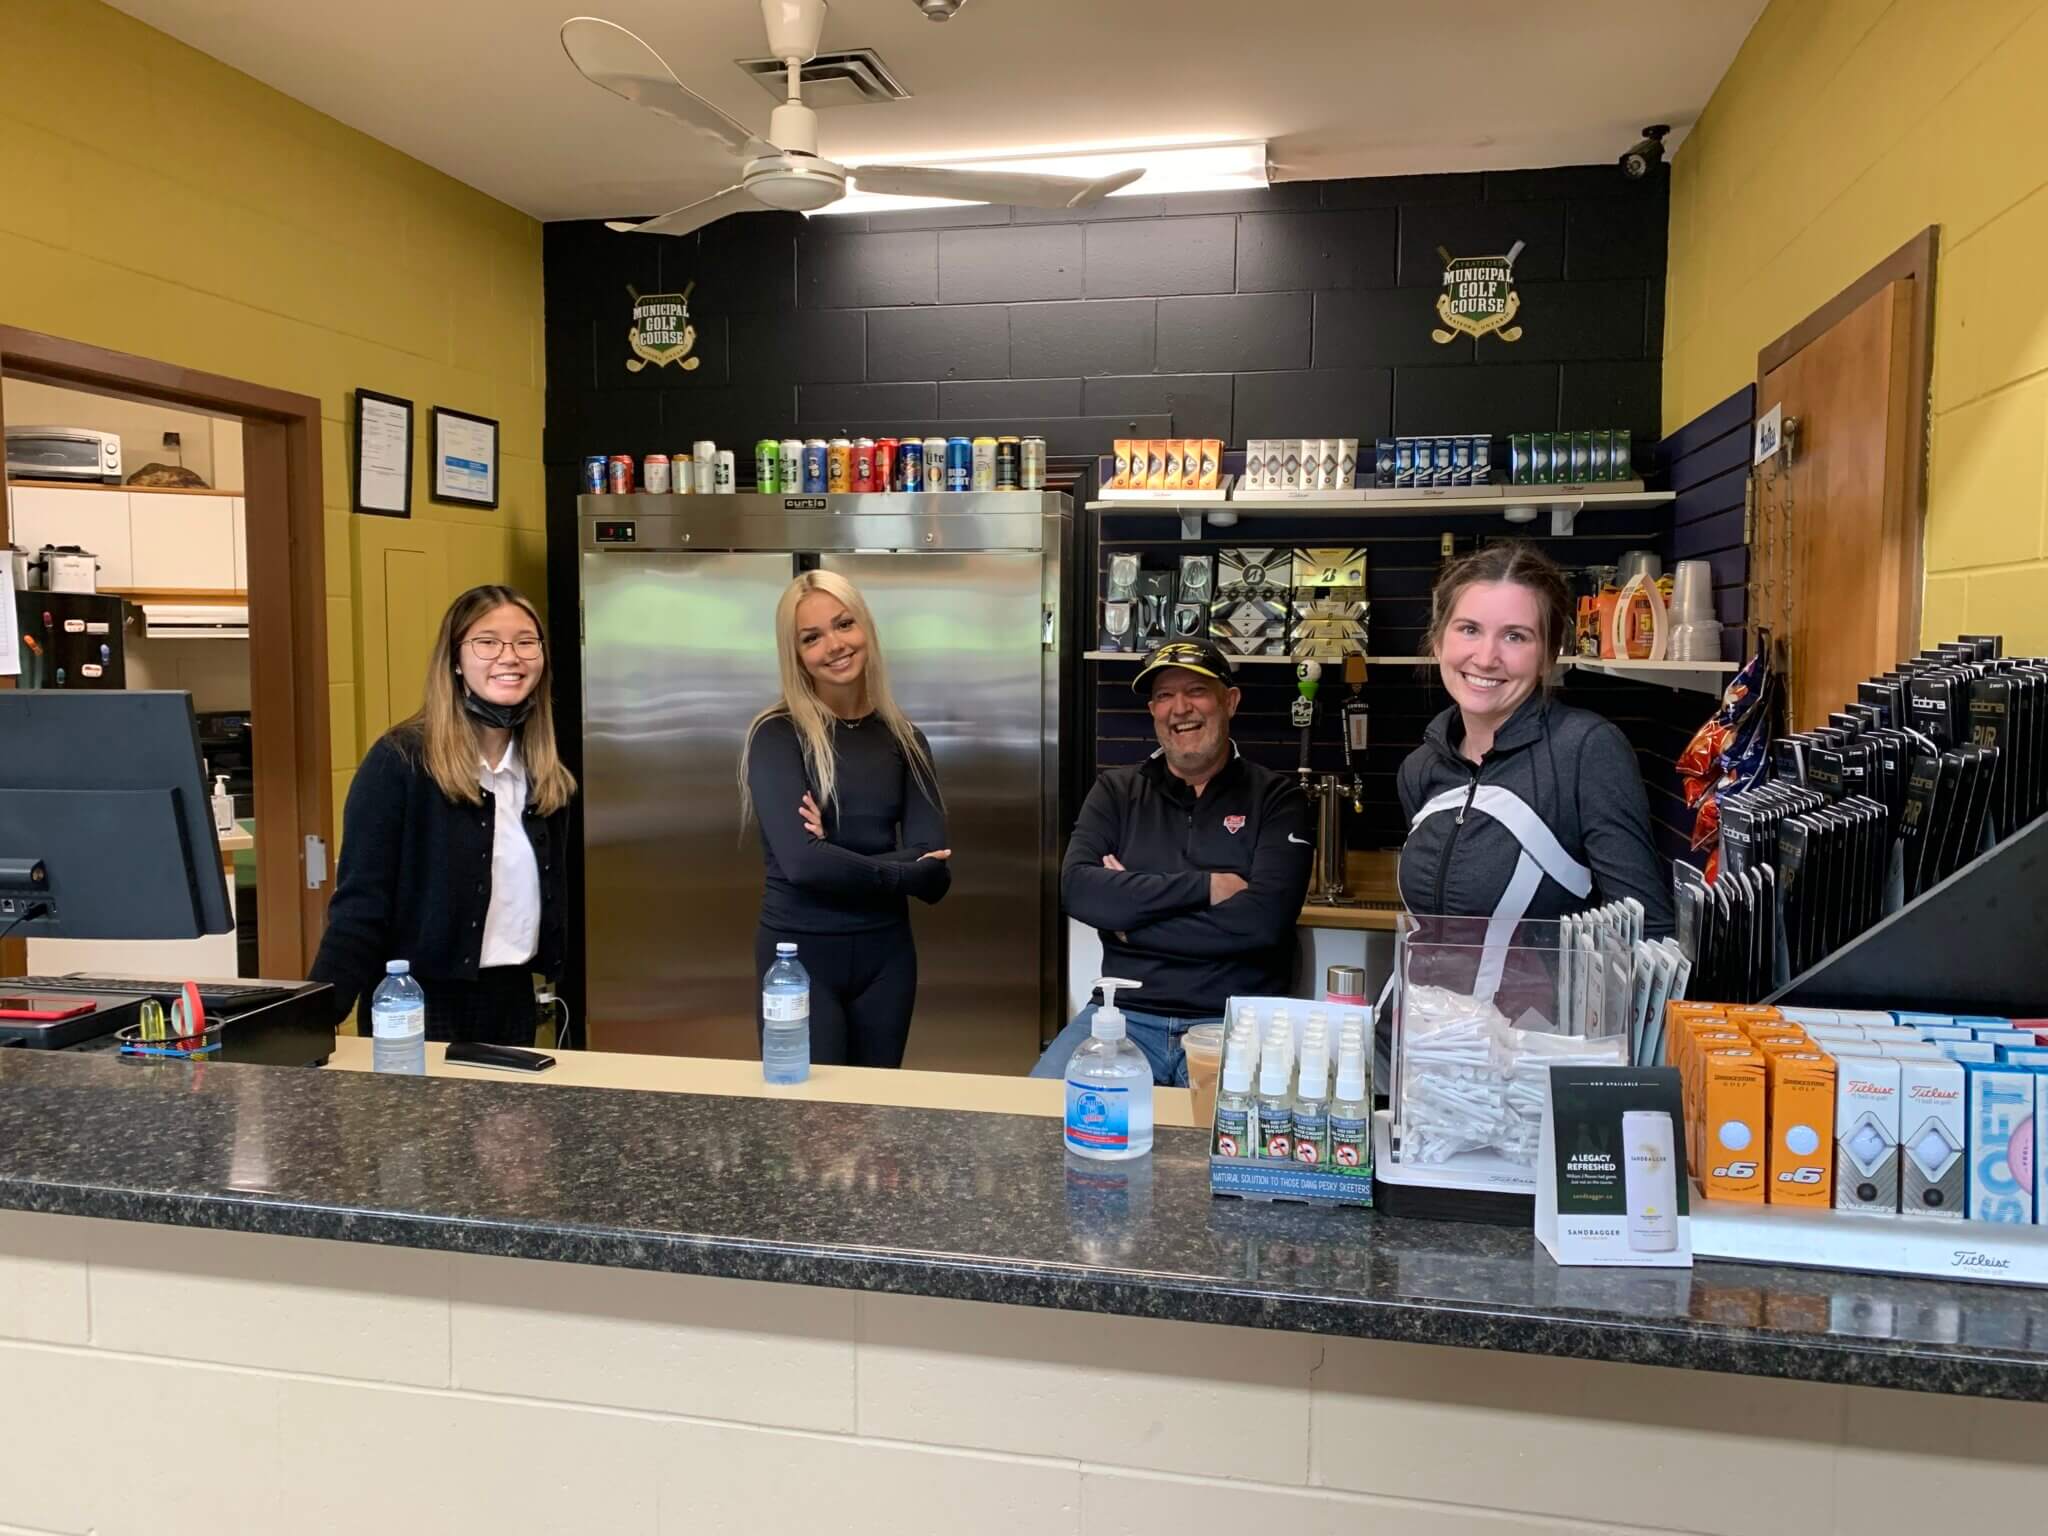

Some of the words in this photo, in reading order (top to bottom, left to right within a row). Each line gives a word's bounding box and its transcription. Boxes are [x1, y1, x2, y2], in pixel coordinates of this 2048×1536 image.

[1443, 268, 1514, 286] MUNICIPAL
[1459, 281, 1497, 298] GOLF
[633, 303, 690, 320] MUNICIPAL
[1451, 298, 1505, 314] COURSE
[646, 316, 677, 331] GOLF
[640, 331, 684, 346] COURSE
[925, 452, 944, 465] Lite
[948, 468, 967, 477] BUD
[786, 500, 825, 508] curtis
[1913, 697, 1947, 710] cobra
[1969, 700, 2005, 713] cobra
[1846, 1081, 1895, 1096] Titleist
[1908, 1085, 1960, 1100] Titleist
[1571, 1154, 1578, 1162] A
[1579, 1154, 1611, 1163] LEGACY
[1567, 1163, 1617, 1172] REFRESHED
[1213, 1172, 1240, 1183] NATURAL
[1240, 1174, 1269, 1185] SOLUTION
[1271, 1177, 1279, 1186] TO
[1280, 1178, 1299, 1188] THOSE
[1301, 1180, 1317, 1190] DANG
[1319, 1182, 1337, 1191] PESKY
[1339, 1183, 1370, 1195] SKEETERS
[1951, 1251, 2011, 1269] Titleist
